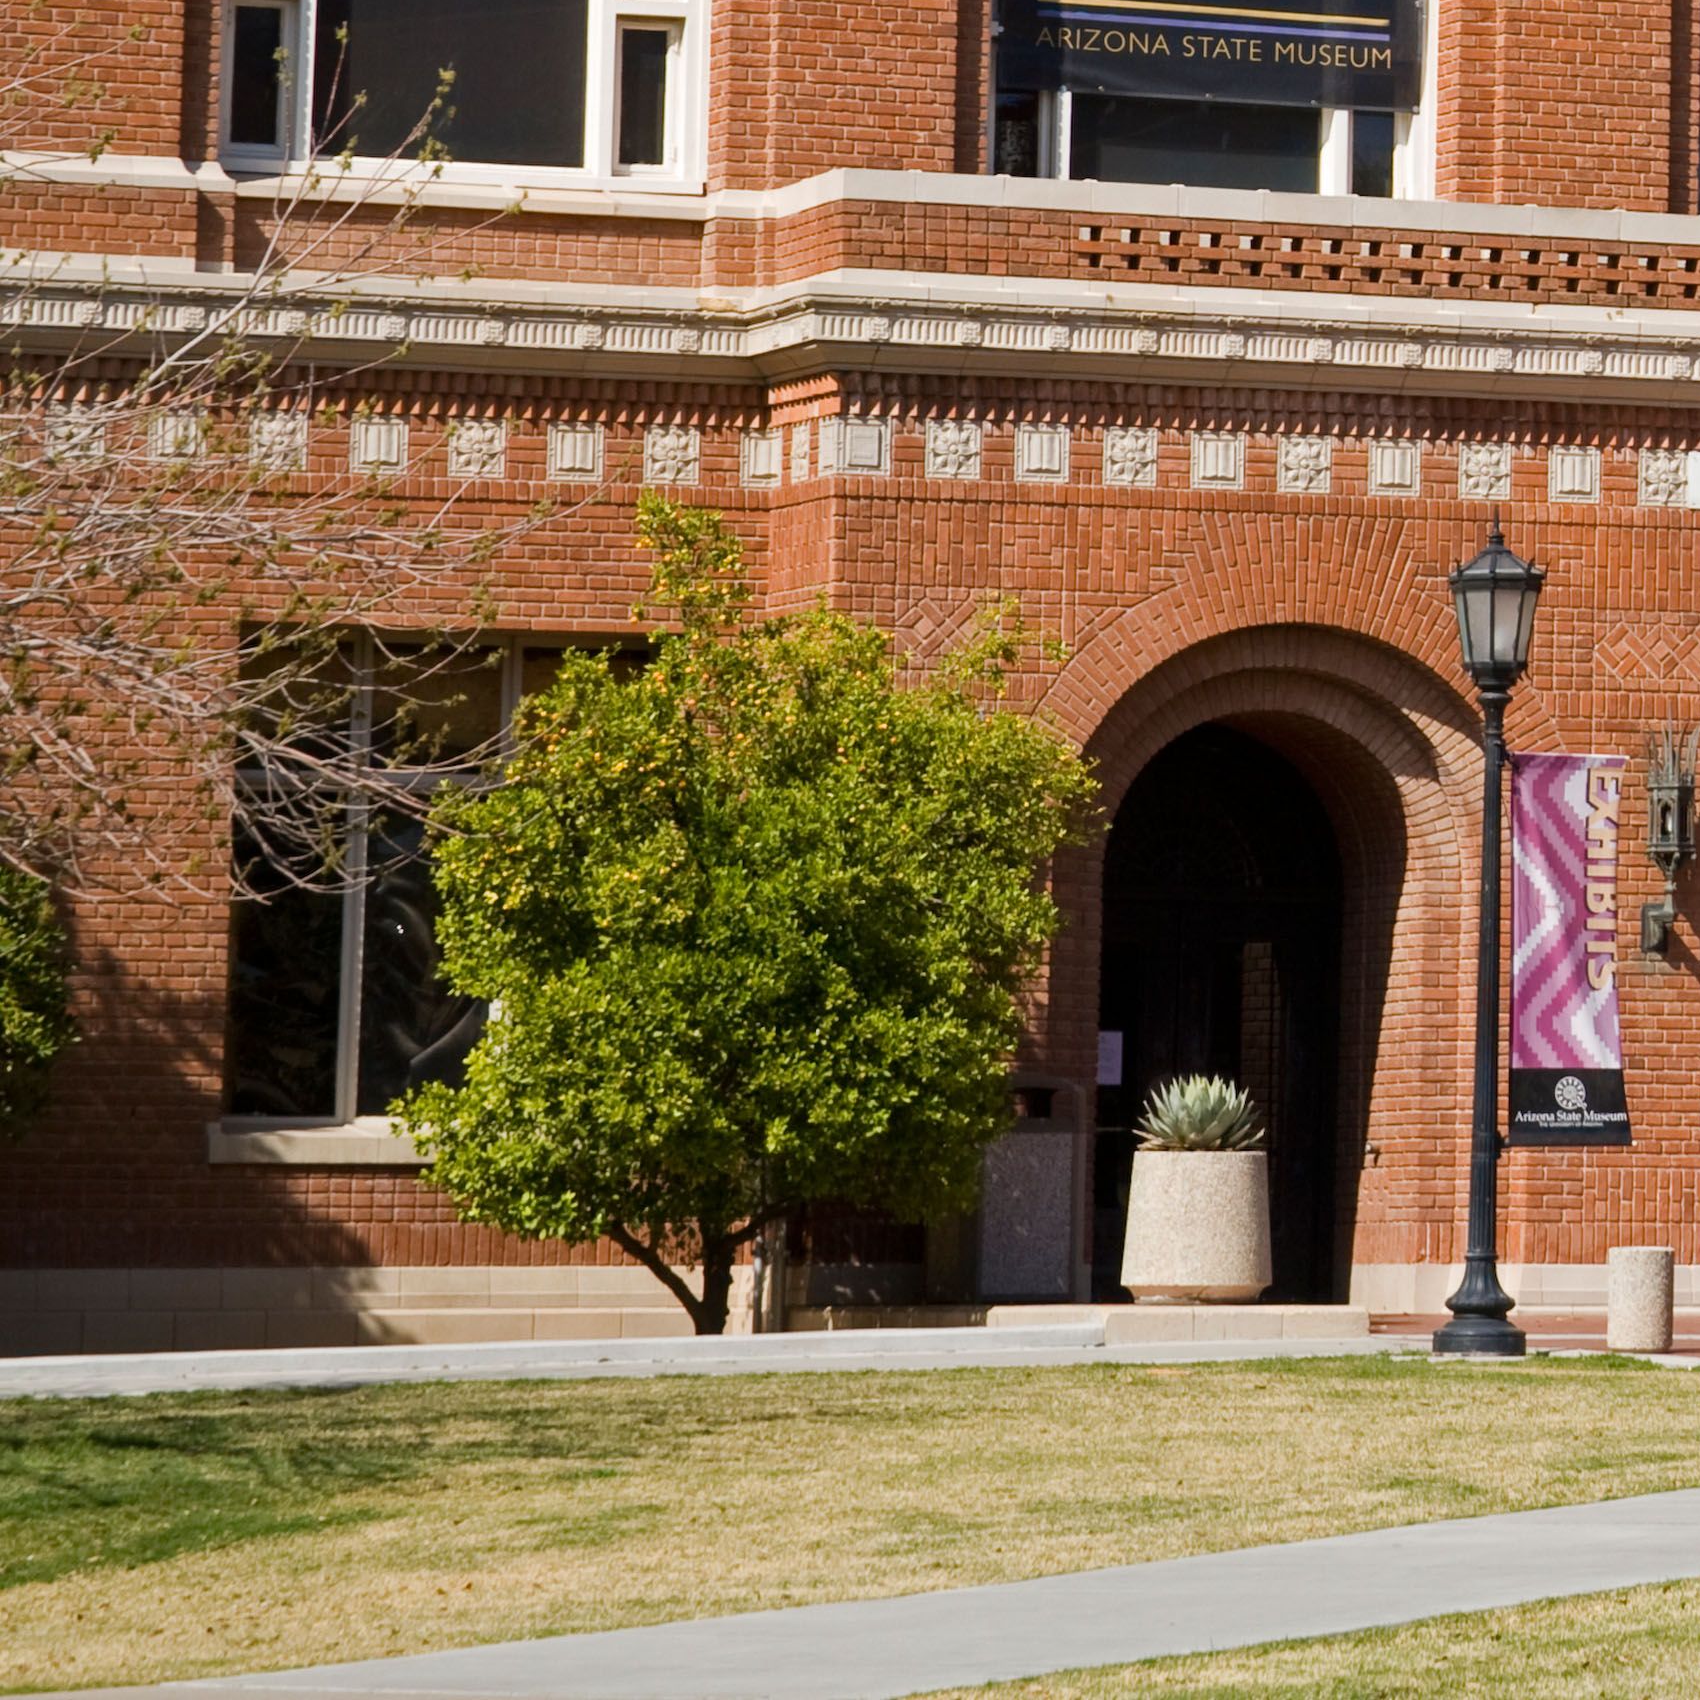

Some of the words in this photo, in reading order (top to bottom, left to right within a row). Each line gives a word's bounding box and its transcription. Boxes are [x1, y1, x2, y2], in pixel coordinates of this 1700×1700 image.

[1036, 27, 1170, 55] ARIZONA
[1182, 36, 1262, 61] STATE
[1275, 41, 1391, 69] MUSEUM
[1585, 766, 1623, 992] EXHIBITS
[1514, 1110, 1555, 1122] Arizona
[1556, 1110, 1581, 1121] State
[1583, 1109, 1627, 1122] Museum
